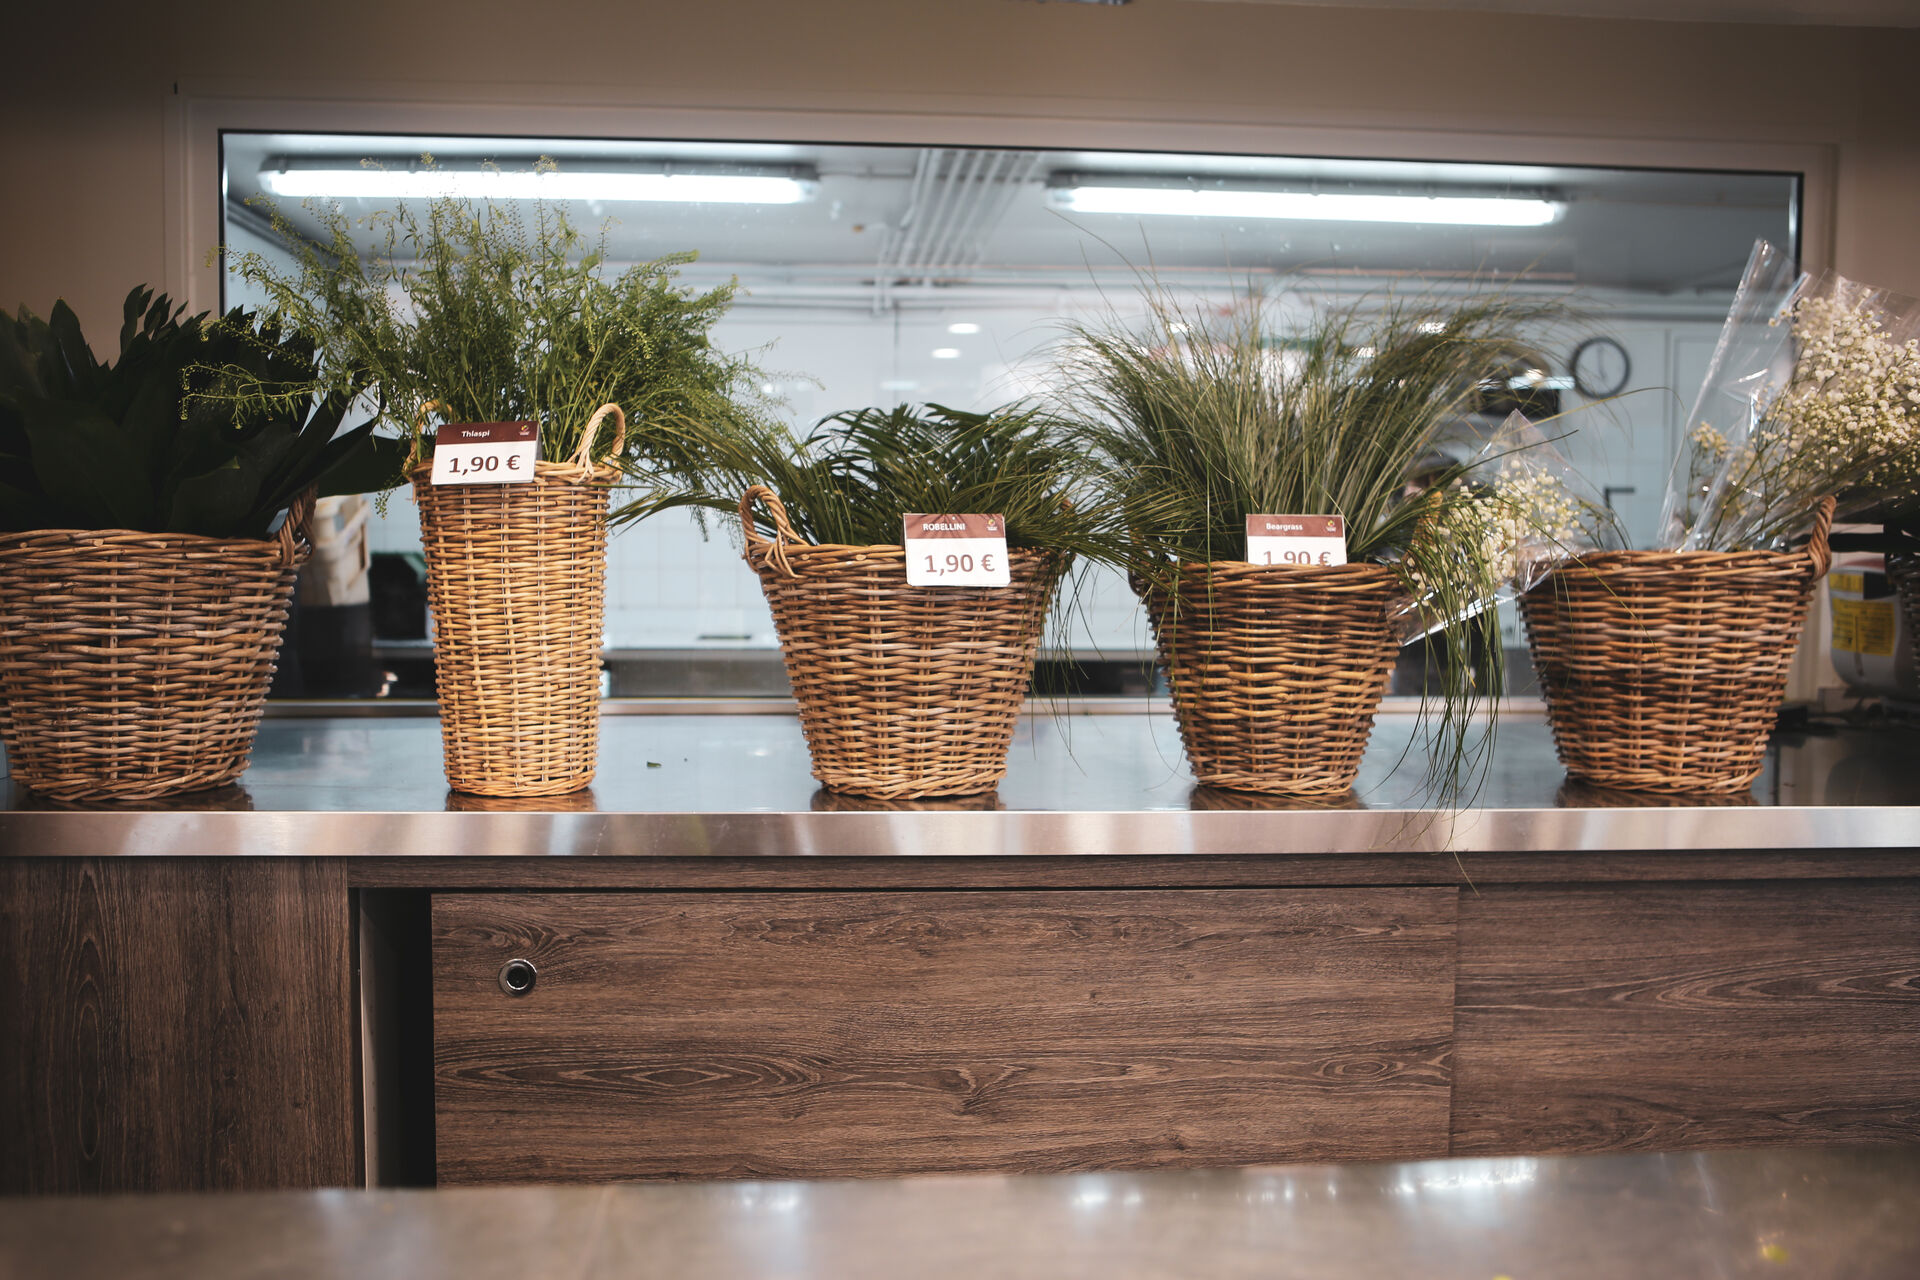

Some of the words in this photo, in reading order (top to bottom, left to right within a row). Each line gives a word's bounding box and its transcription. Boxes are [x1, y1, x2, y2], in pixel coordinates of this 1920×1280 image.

[461, 429, 491, 438] Thlaspi
[449, 456, 499, 476] 1,90
[506, 455, 521, 470] €
[922, 523, 966, 531] ROBELLINI
[1265, 522, 1303, 531] Beargrass
[1263, 550, 1312, 566] 190
[1318, 551, 1332, 567] €
[924, 554, 974, 577] 1,90
[980, 554, 996, 572] €
